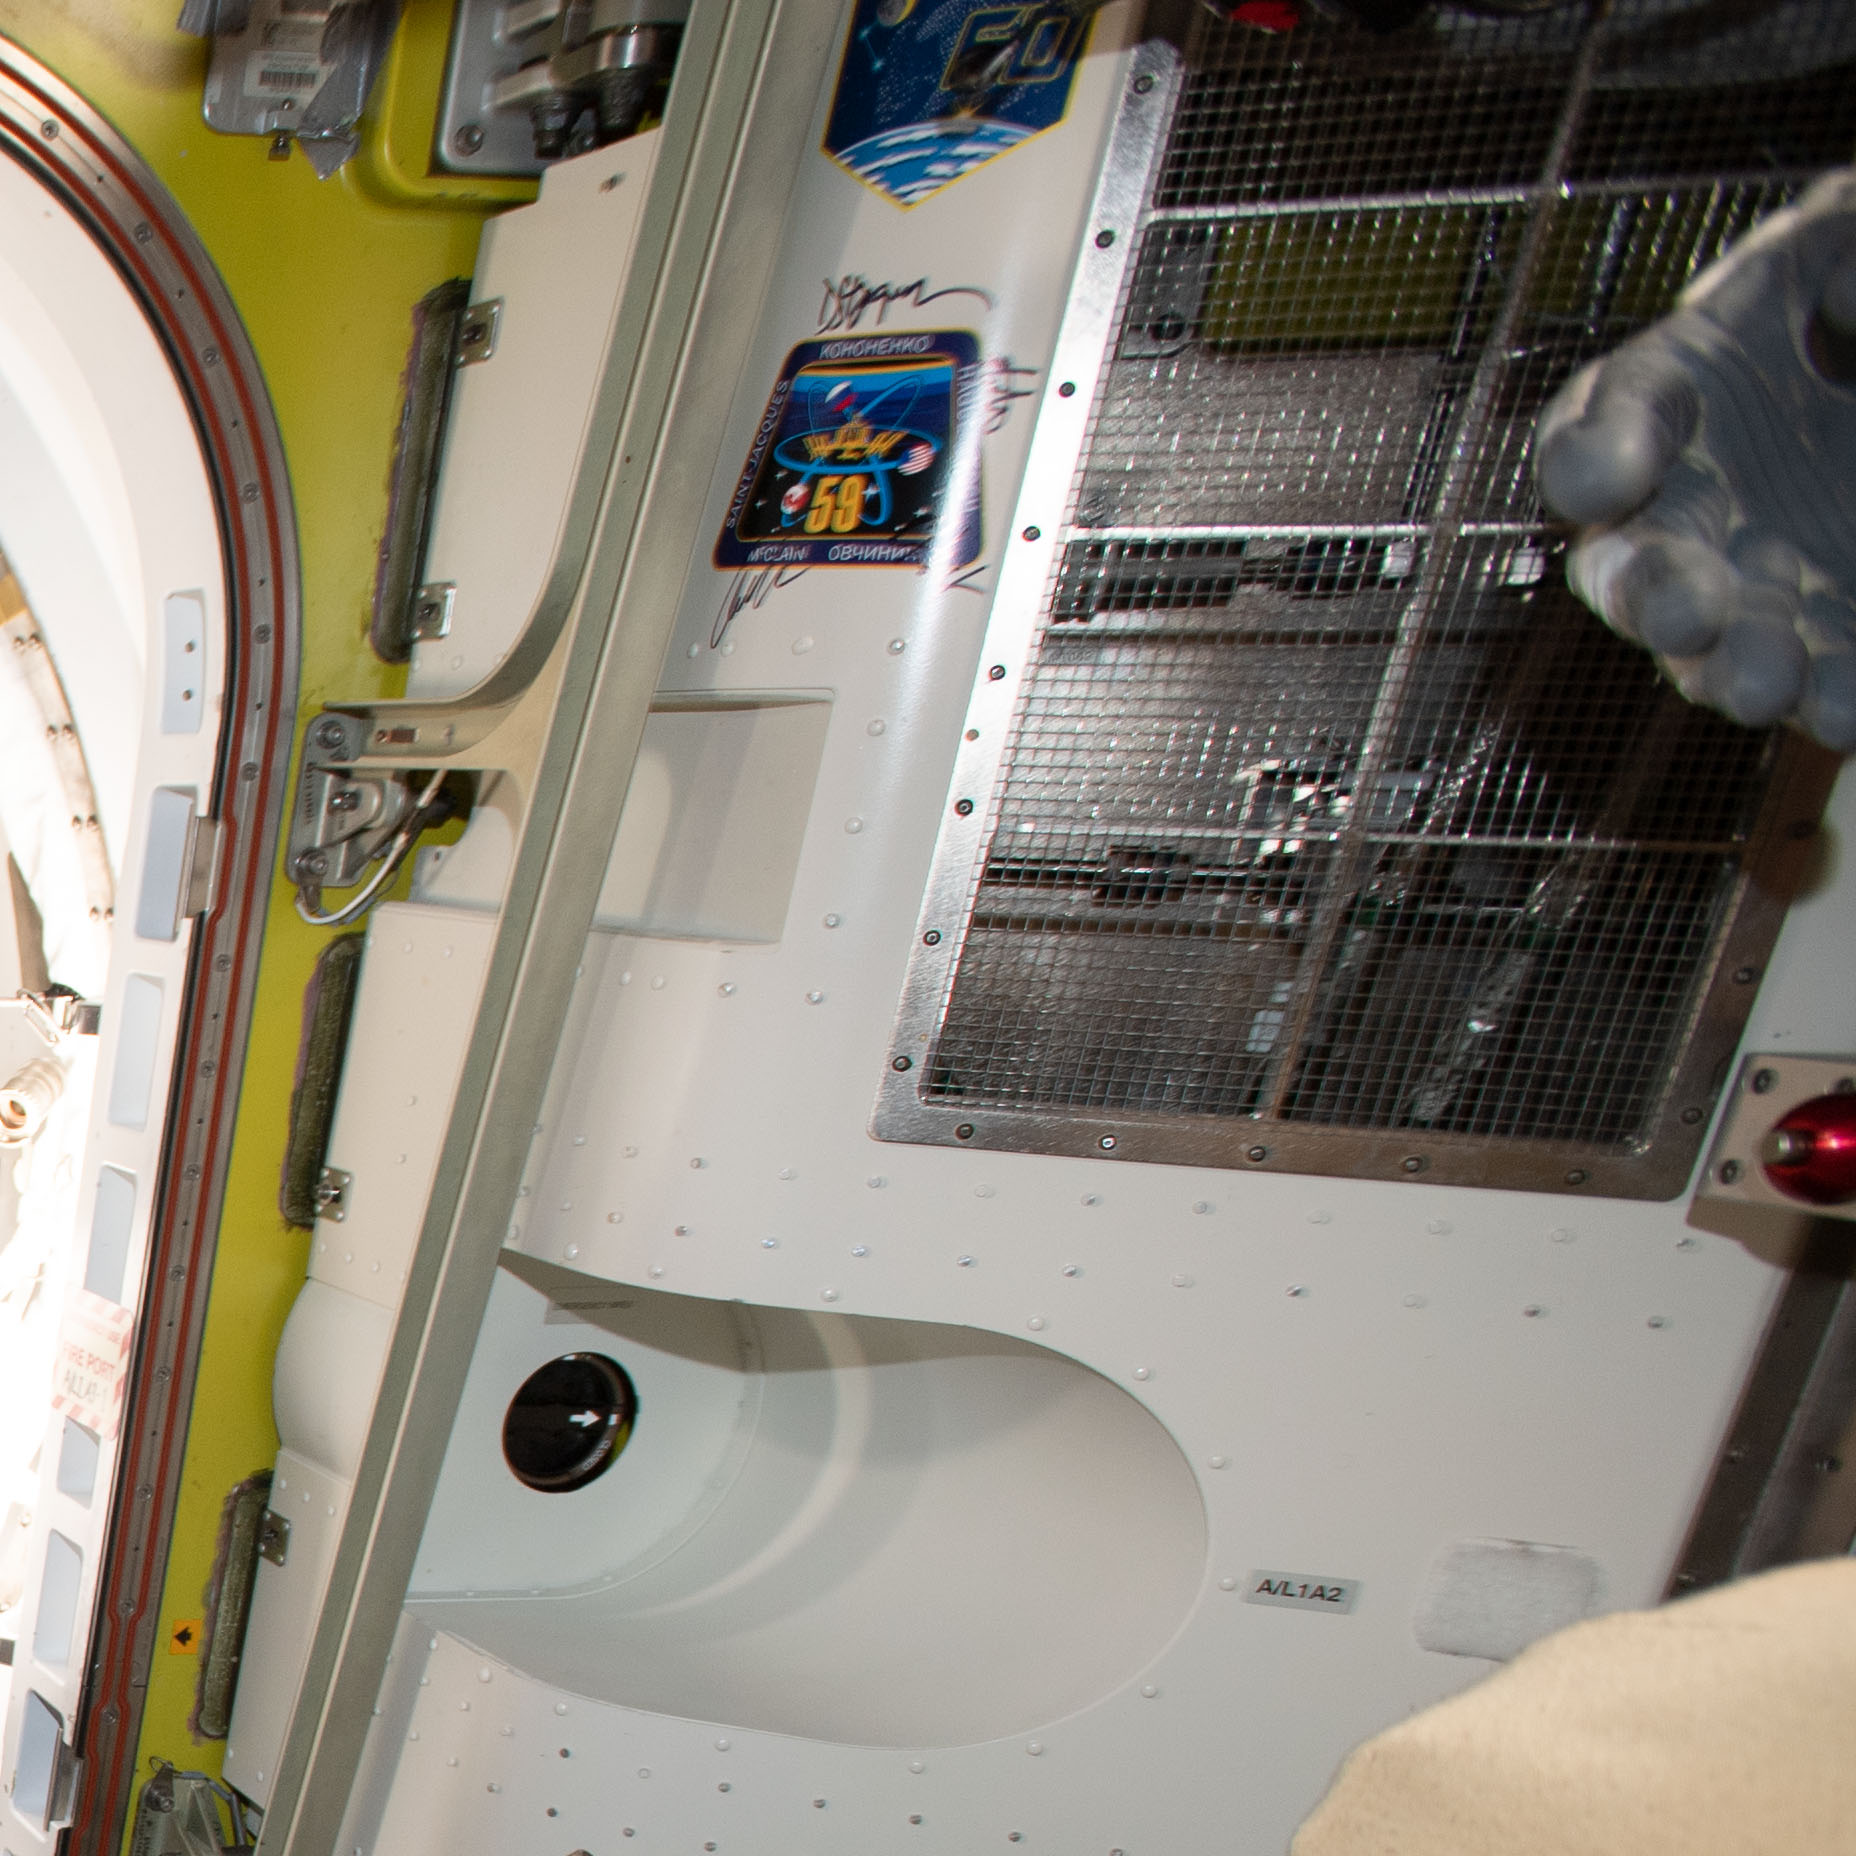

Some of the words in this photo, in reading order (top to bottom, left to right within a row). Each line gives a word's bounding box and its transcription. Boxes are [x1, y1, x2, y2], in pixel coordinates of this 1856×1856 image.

[818, 333, 935, 359] КОНОНЕНКО
[803, 474, 871, 534] 59
[1255, 1578, 1344, 1603] A/L1A2
